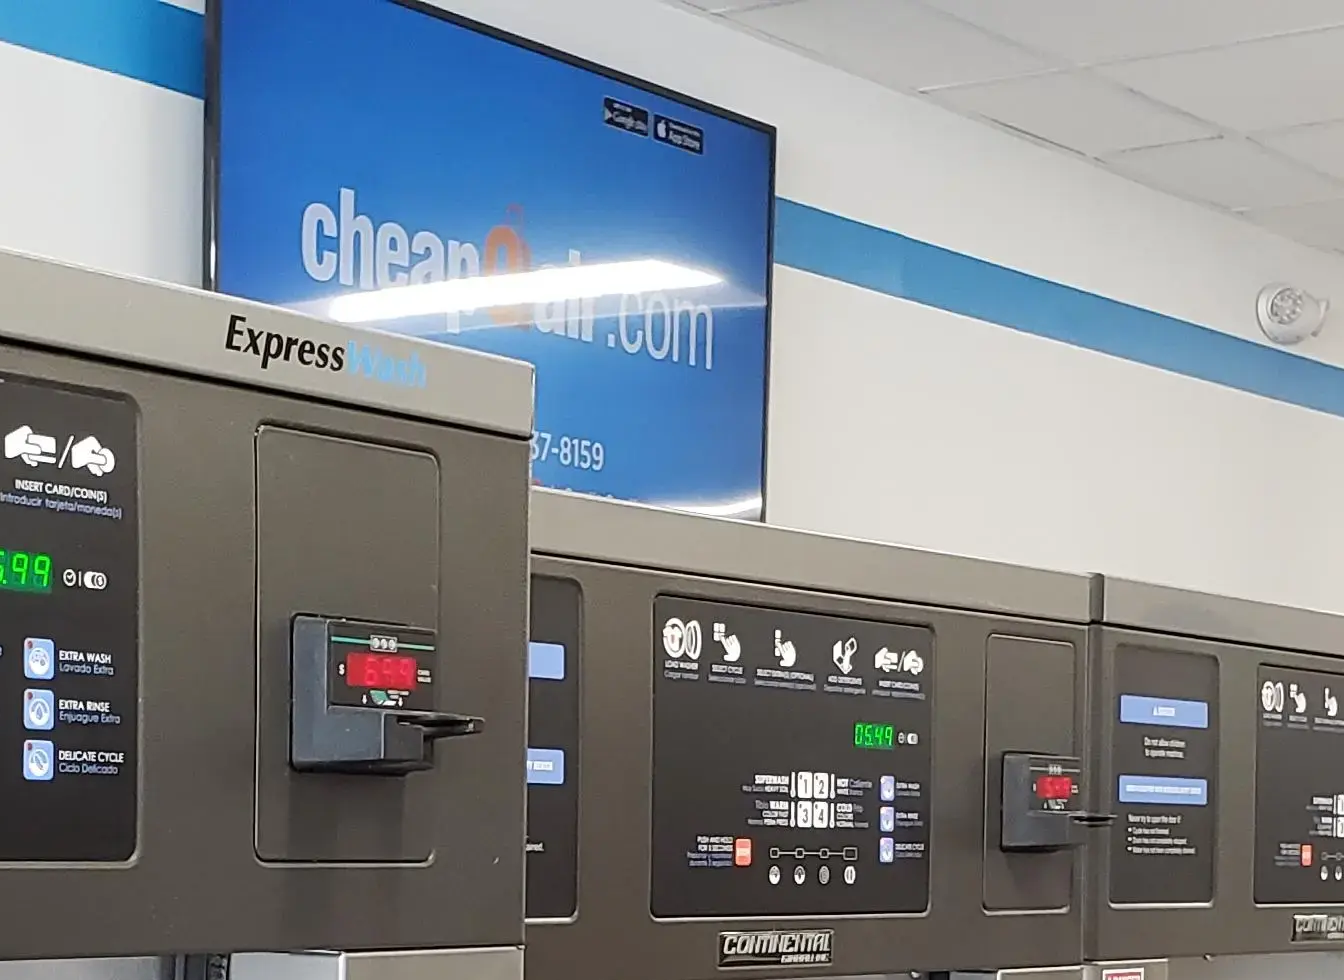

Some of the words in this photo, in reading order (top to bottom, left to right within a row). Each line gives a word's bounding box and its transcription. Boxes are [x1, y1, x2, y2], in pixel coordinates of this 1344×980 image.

[14, 479, 43, 493] INSERT
[59, 650, 84, 662] EXTRA
[86, 653, 111, 664] WASH
[59, 699, 84, 711] EXTRA
[86, 701, 110, 712] RINSE
[58, 750, 97, 762] DELICATE
[98, 752, 124, 763] CYCLE
